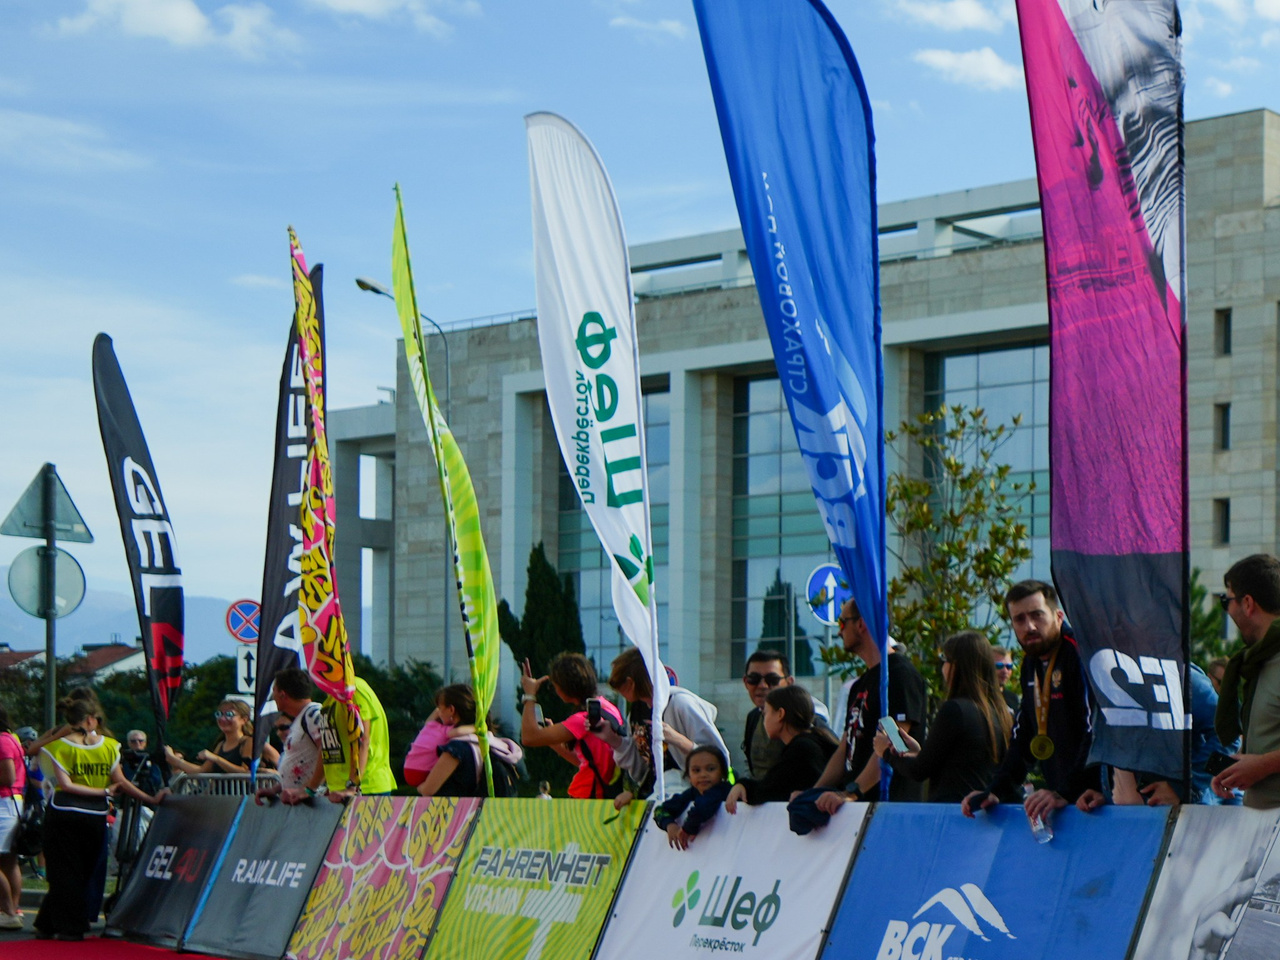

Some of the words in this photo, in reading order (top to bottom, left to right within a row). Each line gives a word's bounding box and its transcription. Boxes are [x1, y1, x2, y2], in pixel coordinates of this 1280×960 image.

[123, 455, 182, 617] GEL
[145, 845, 178, 880] GEL
[175, 848, 208, 883] 4U
[472, 846, 612, 887] FAHRENHEIT
[464, 883, 523, 916] VITAMIN
[698, 875, 781, 946] Шеф
